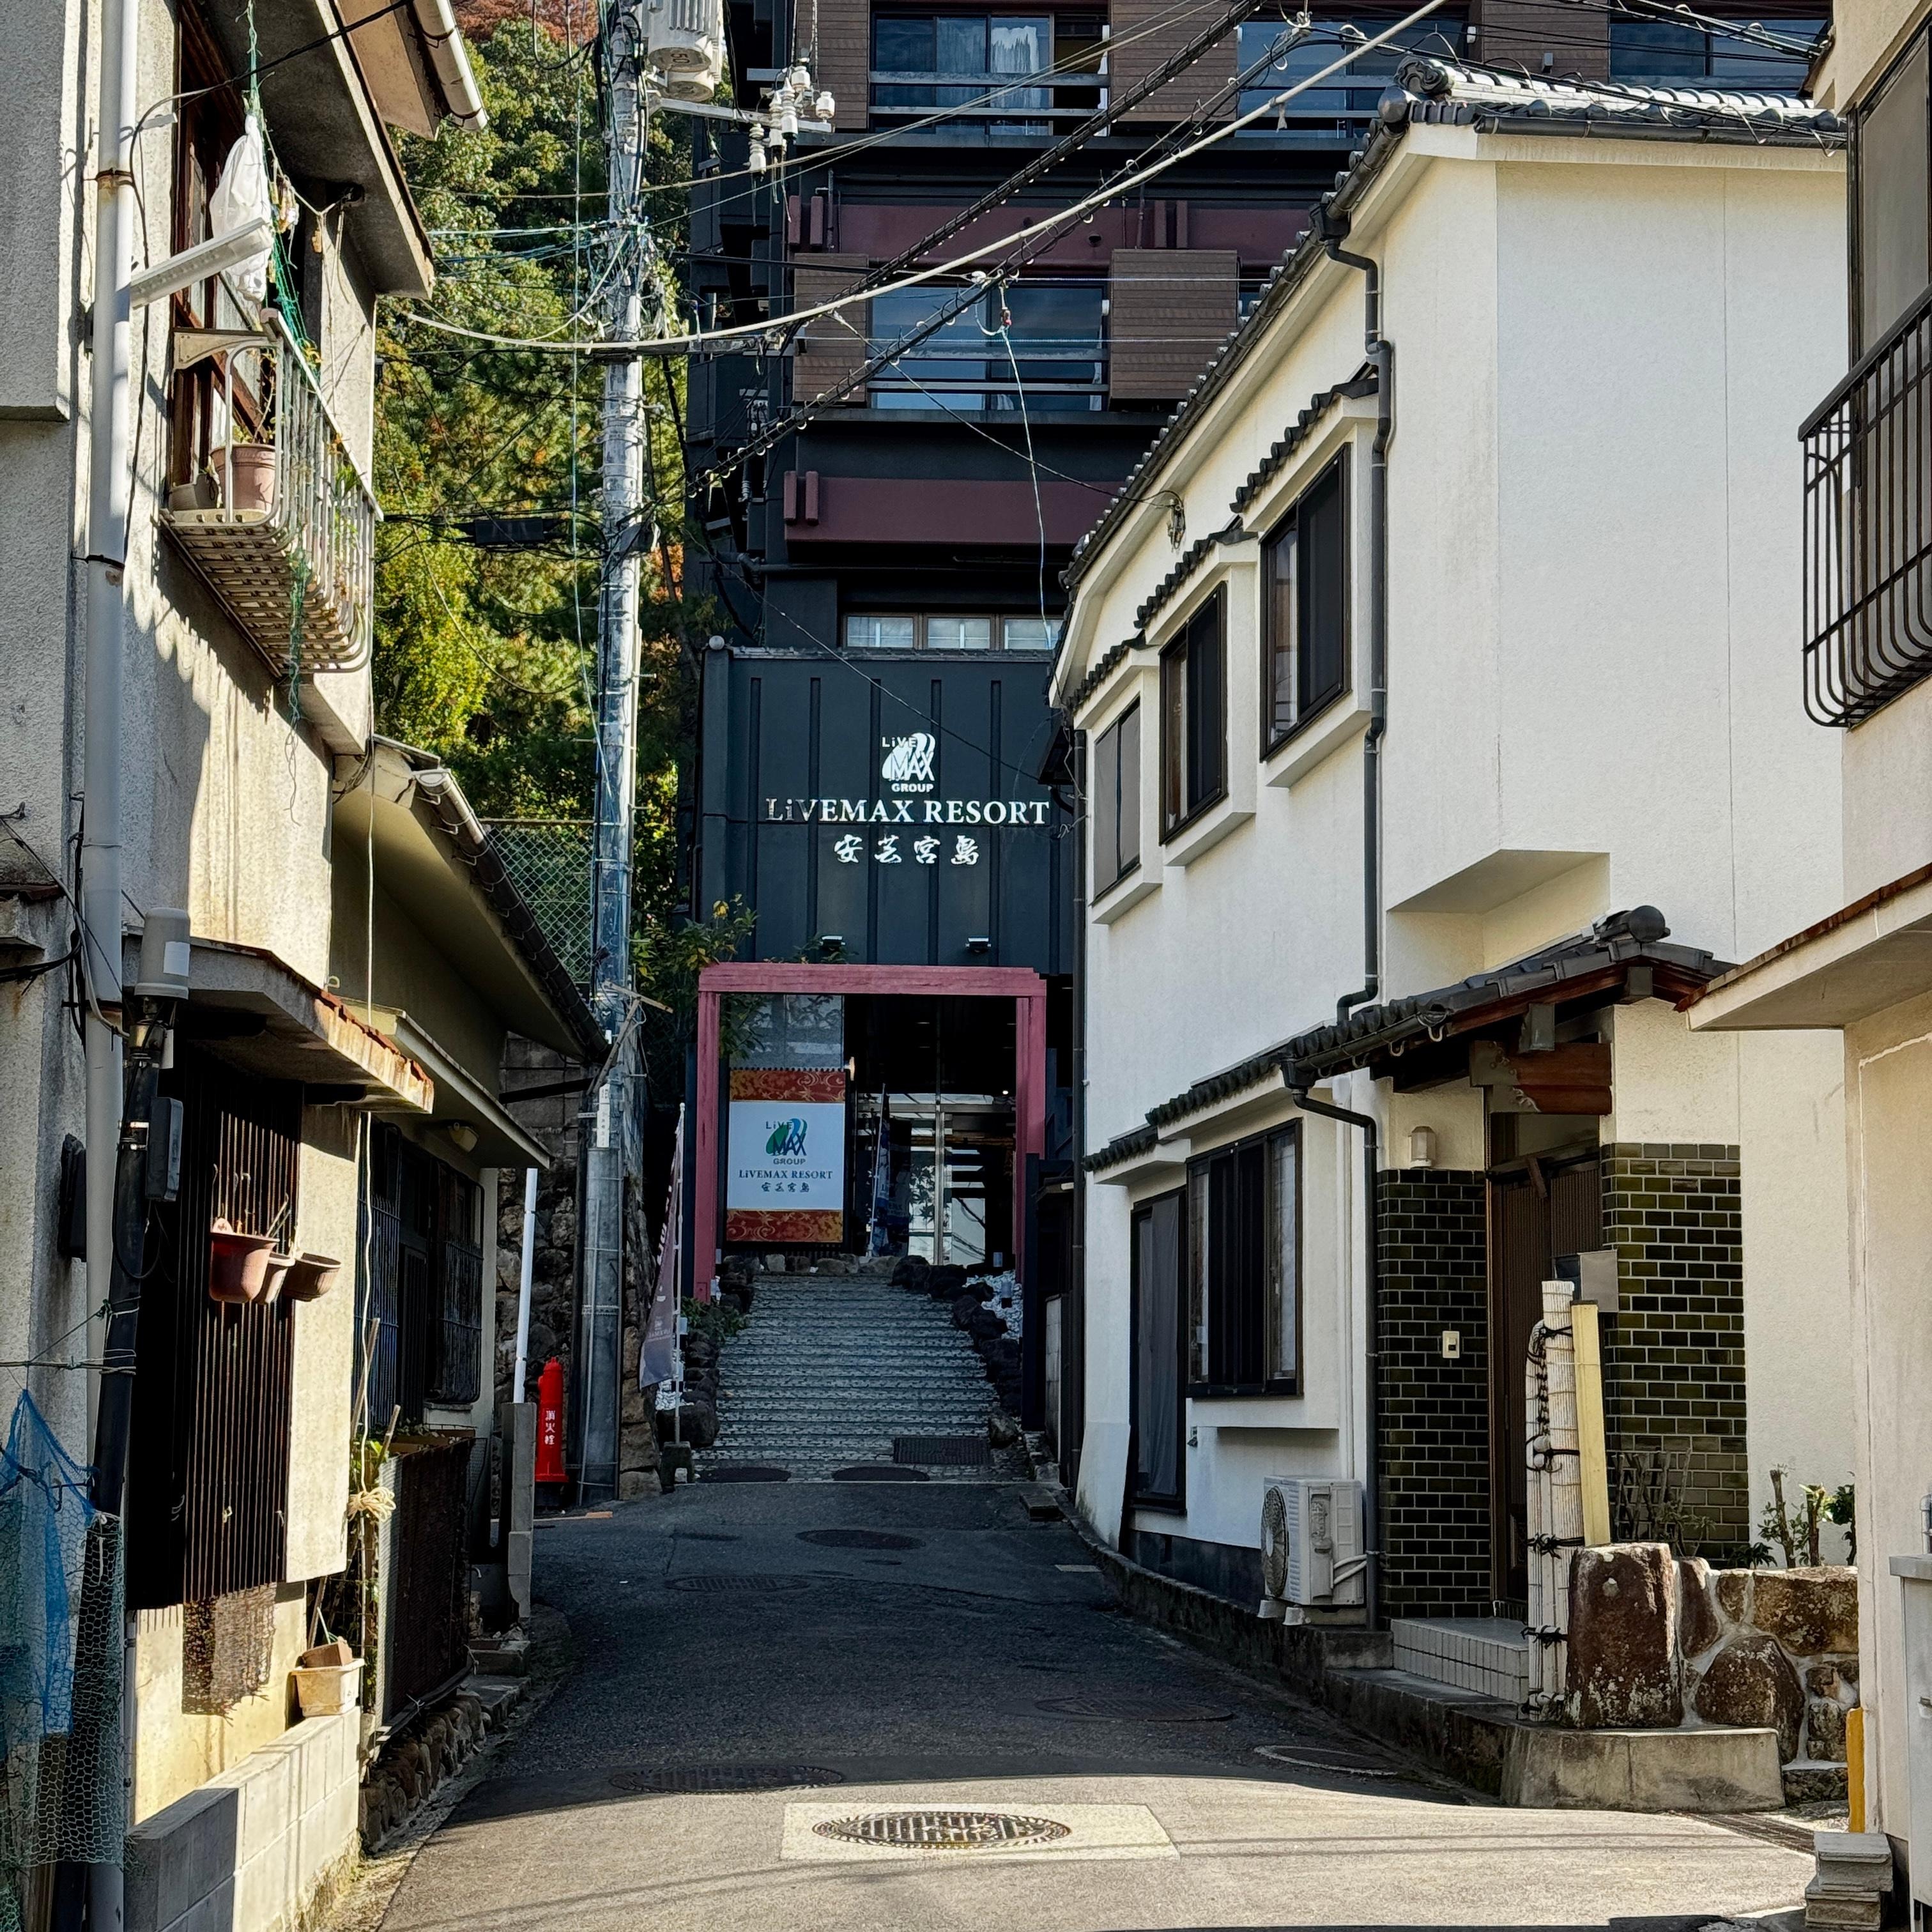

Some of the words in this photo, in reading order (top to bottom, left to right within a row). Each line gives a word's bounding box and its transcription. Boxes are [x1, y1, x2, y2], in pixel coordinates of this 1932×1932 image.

[882, 737, 917, 747] LiVE
[891, 751, 935, 781] MAX
[891, 783, 934, 792] GROUP
[766, 799, 914, 822] LiVEMAX
[923, 801, 1049, 824] RESORT
[834, 834, 979, 865] 安芸宮島
[772, 1133, 807, 1156] MAX
[791, 1170, 833, 1179] RESORT
[544, 1409, 556, 1445] 消火栓
